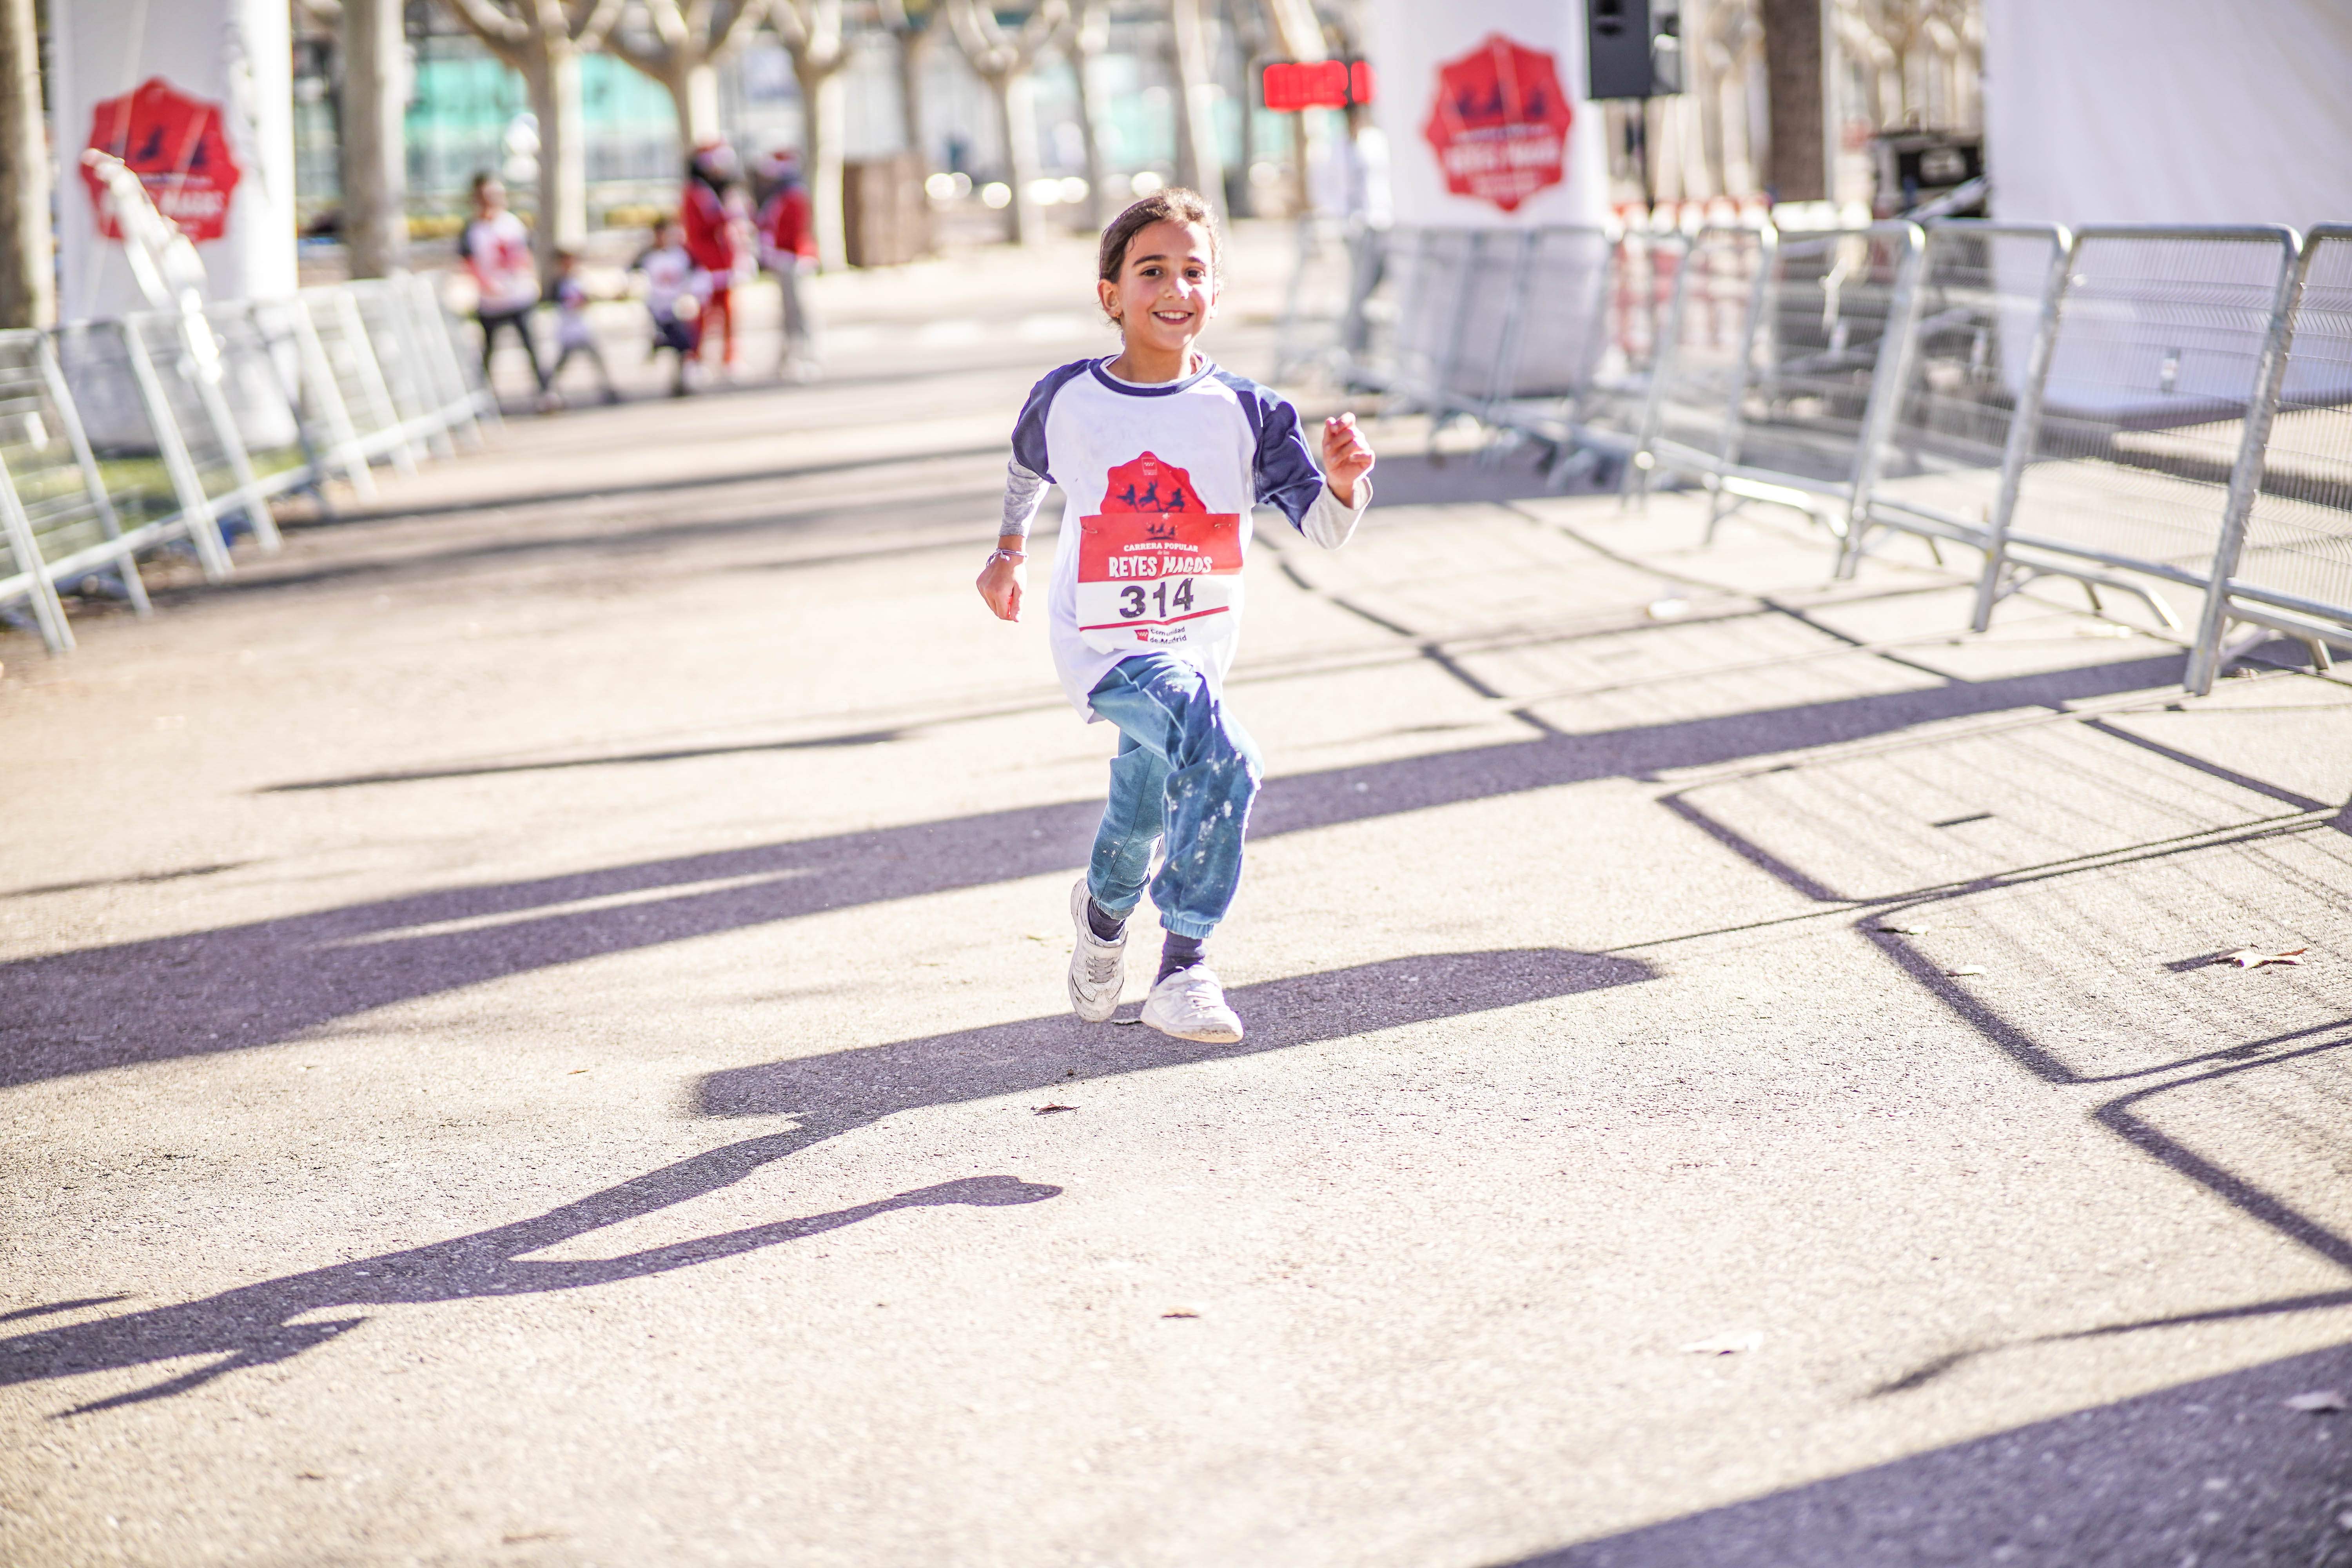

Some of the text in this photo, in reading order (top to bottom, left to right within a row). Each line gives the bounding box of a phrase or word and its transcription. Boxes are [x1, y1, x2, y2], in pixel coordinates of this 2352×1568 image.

[1123, 543, 1198, 552] CARRERA POPULAR
[1109, 555, 1213, 577] REYES MAGOS
[1120, 578, 1194, 617] 314
